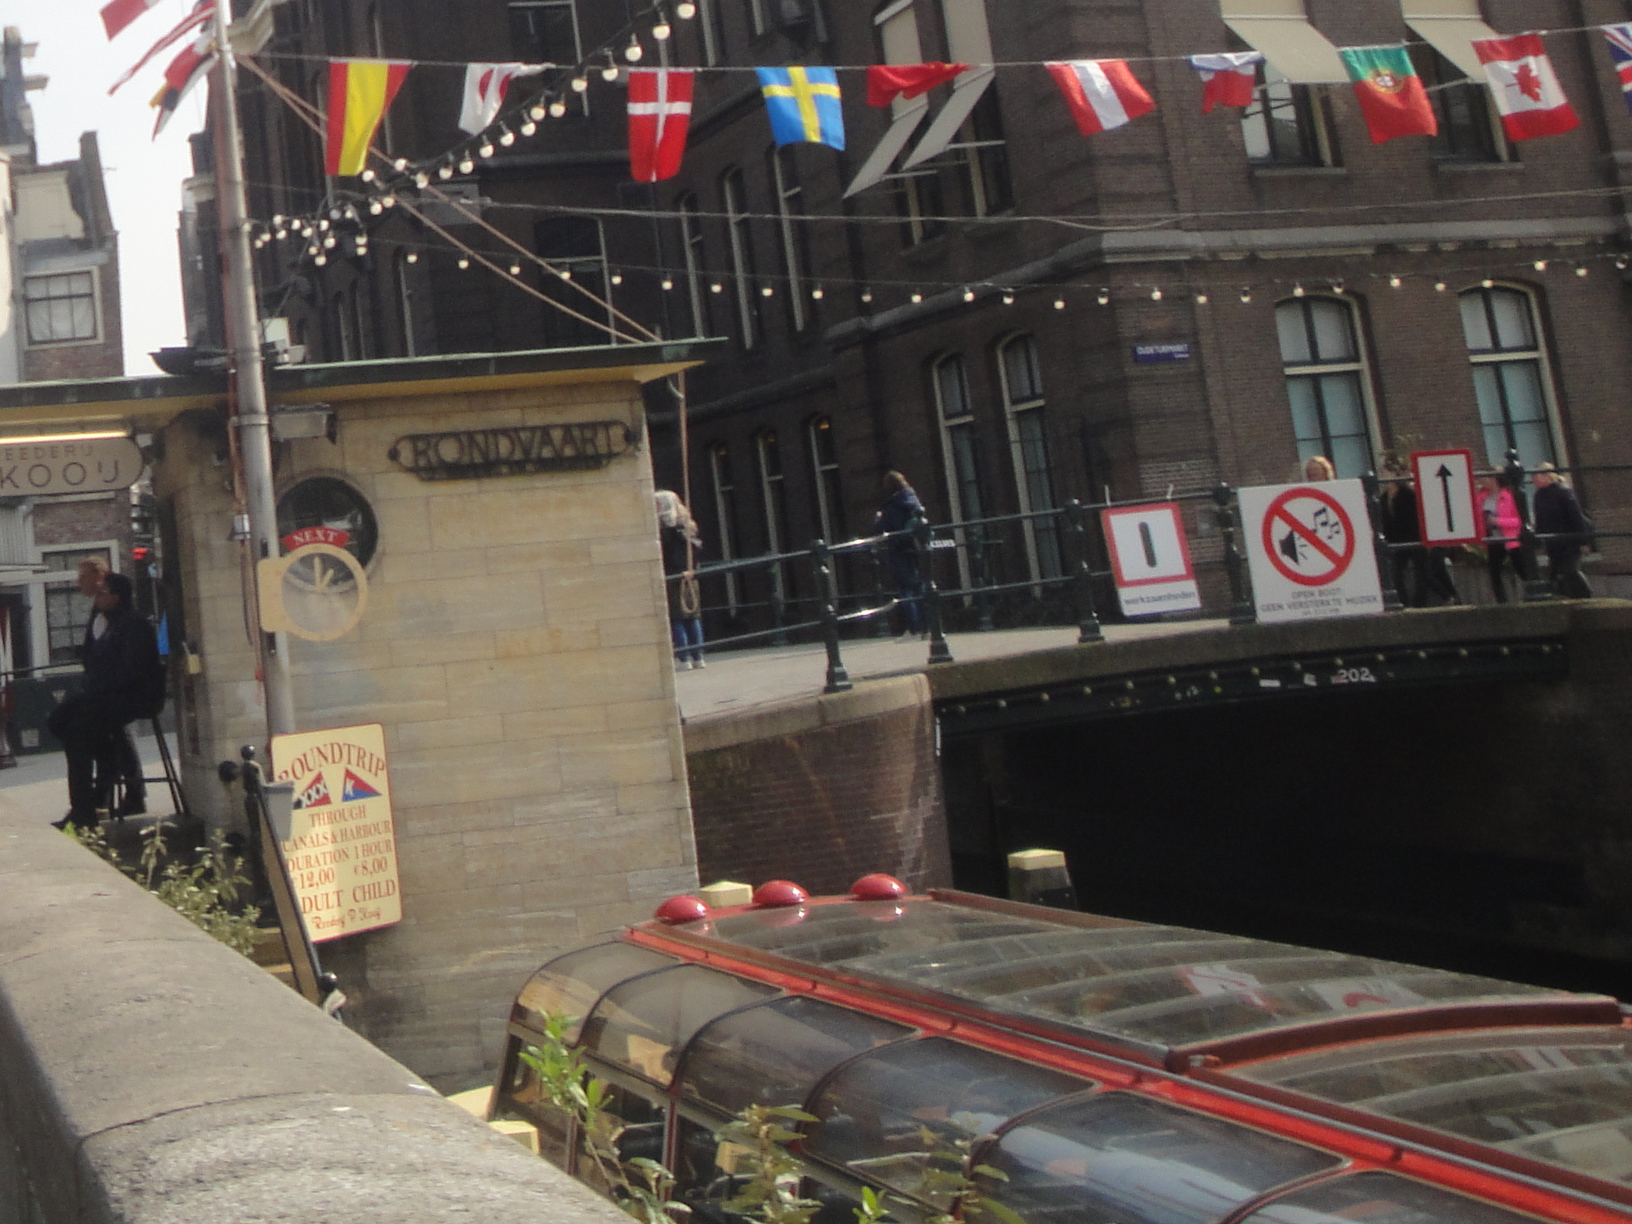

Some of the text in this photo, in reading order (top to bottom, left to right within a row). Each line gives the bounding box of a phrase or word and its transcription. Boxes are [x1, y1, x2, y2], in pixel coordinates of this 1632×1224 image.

[413, 424, 624, 470] RONDVAART
[292, 529, 338, 546] NEXT
[1125, 591, 1196, 606] werkzaamheden
[1338, 667, 1372, 684] 202
[308, 804, 366, 828] THROUGH
[287, 846, 350, 873] DURATION
[361, 838, 393, 858] HOUR
[301, 878, 397, 914] DULT CHILD
